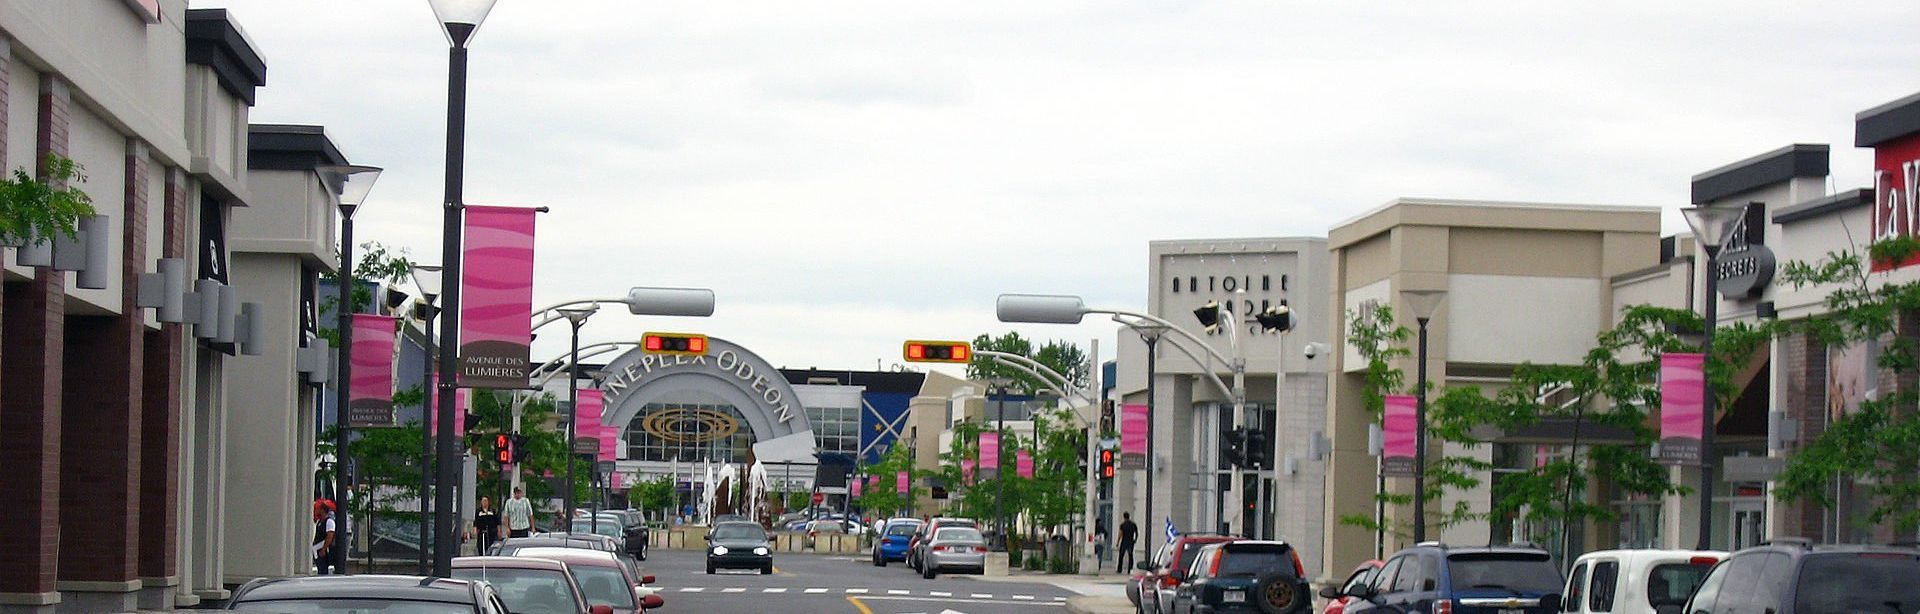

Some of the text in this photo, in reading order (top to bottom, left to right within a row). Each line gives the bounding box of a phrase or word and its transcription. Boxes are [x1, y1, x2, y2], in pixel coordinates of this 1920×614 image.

[1873, 159, 1920, 245] La V
[1172, 274, 1288, 293] ANTOINE
[466, 356, 524, 366] AVENUE DES
[465, 365, 524, 378] LUMIÈRES
[600, 349, 795, 424] INEPLEX ODEON
